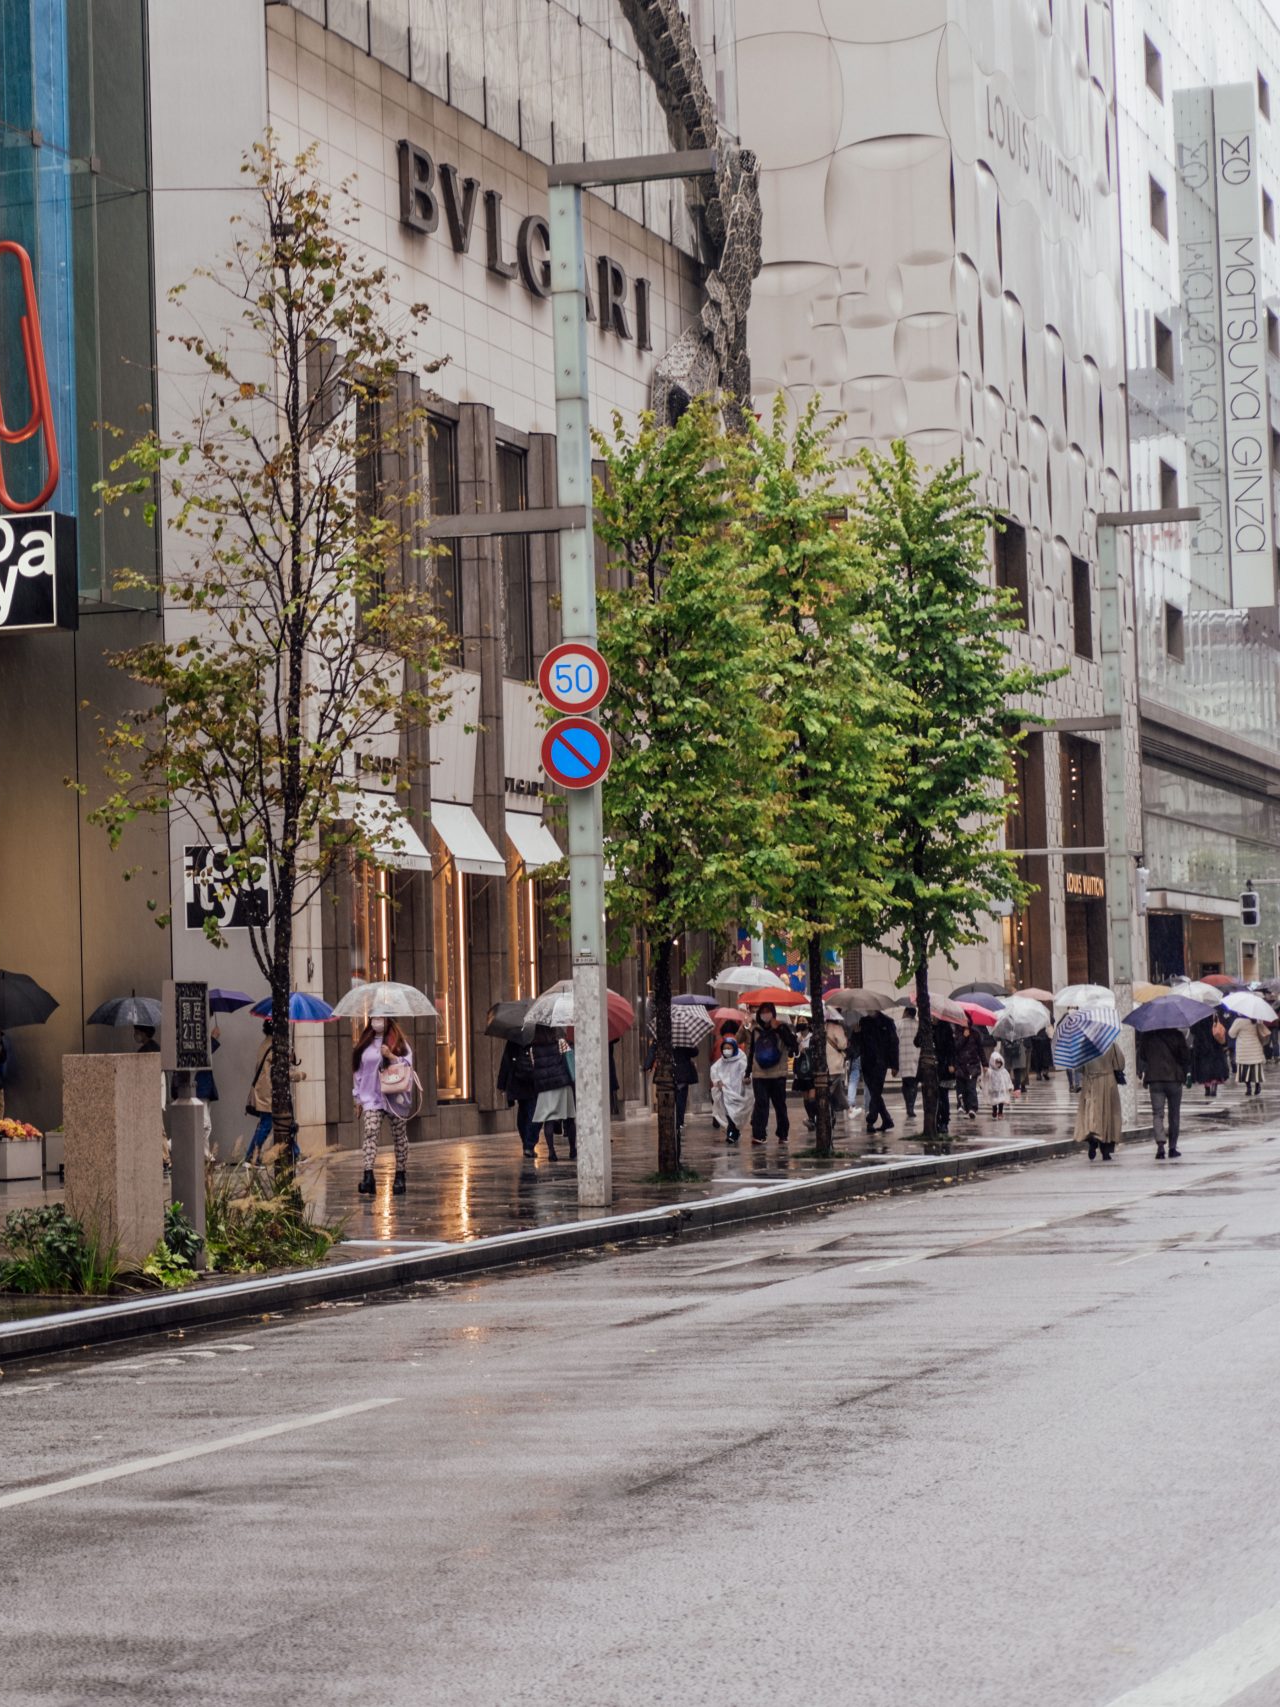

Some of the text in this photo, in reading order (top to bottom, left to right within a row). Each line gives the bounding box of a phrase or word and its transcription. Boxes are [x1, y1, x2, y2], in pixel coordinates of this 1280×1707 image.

[986, 84, 1092, 233] LOUIS VUITTON
[396, 139, 653, 351] BVLGRI
[555, 664, 593, 693] 50
[1067, 872, 1104, 897] LOUIS VUITTON
